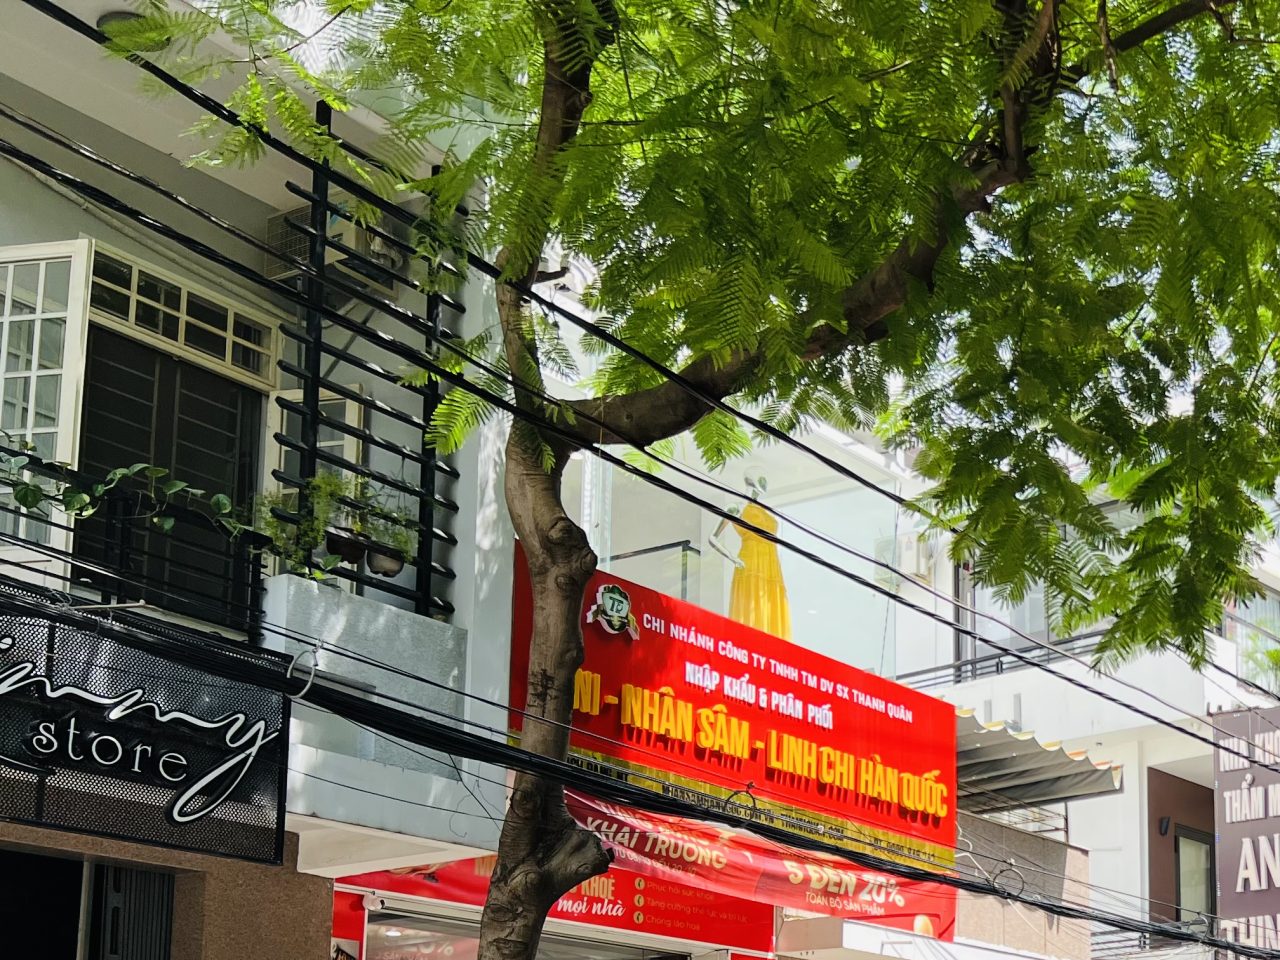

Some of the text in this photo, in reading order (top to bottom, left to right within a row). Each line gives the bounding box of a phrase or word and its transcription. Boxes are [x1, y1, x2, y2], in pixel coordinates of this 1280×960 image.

[643, 613, 913, 724] CHI NHÁNH CÔNG TY TNHH TM DV SX THANH QUÂN
[685, 661, 720, 694] NHẬP
[723, 673, 757, 705] KHẨU
[771, 690, 803, 720] PHÂN
[807, 703, 833, 730] PHỐI
[33, 717, 188, 781] store
[621, 683, 693, 742] NHÂN
[696, 703, 749, 760] SÂM
[767, 729, 817, 780] LINH
[819, 746, 855, 791] CHI
[858, 754, 898, 804] HÀN
[900, 769, 948, 818] QUỐC
[1219, 736, 1251, 772] NHA
[1223, 773, 1266, 824] THẨM
[557, 896, 626, 916] mọi nhà
